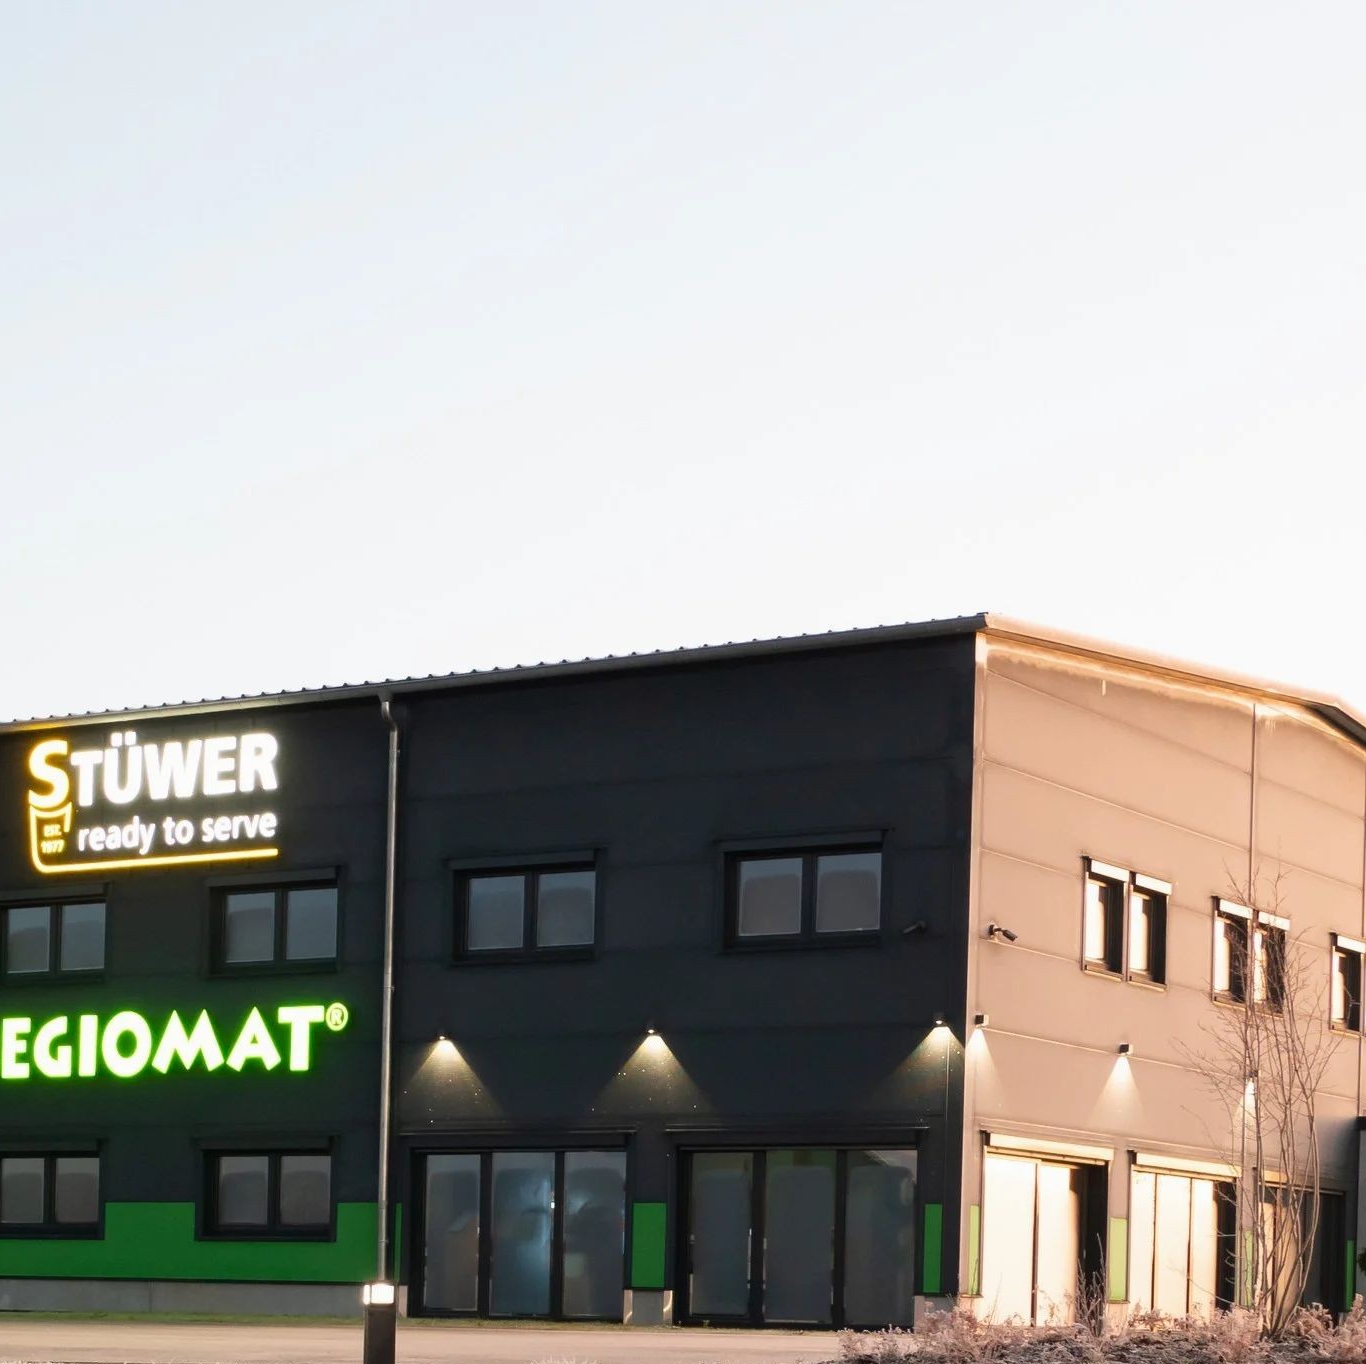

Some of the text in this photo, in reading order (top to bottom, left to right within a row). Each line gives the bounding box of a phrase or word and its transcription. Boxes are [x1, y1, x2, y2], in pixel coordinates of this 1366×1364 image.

[28, 731, 279, 808] STÜWER
[78, 811, 277, 855] ready to serve
